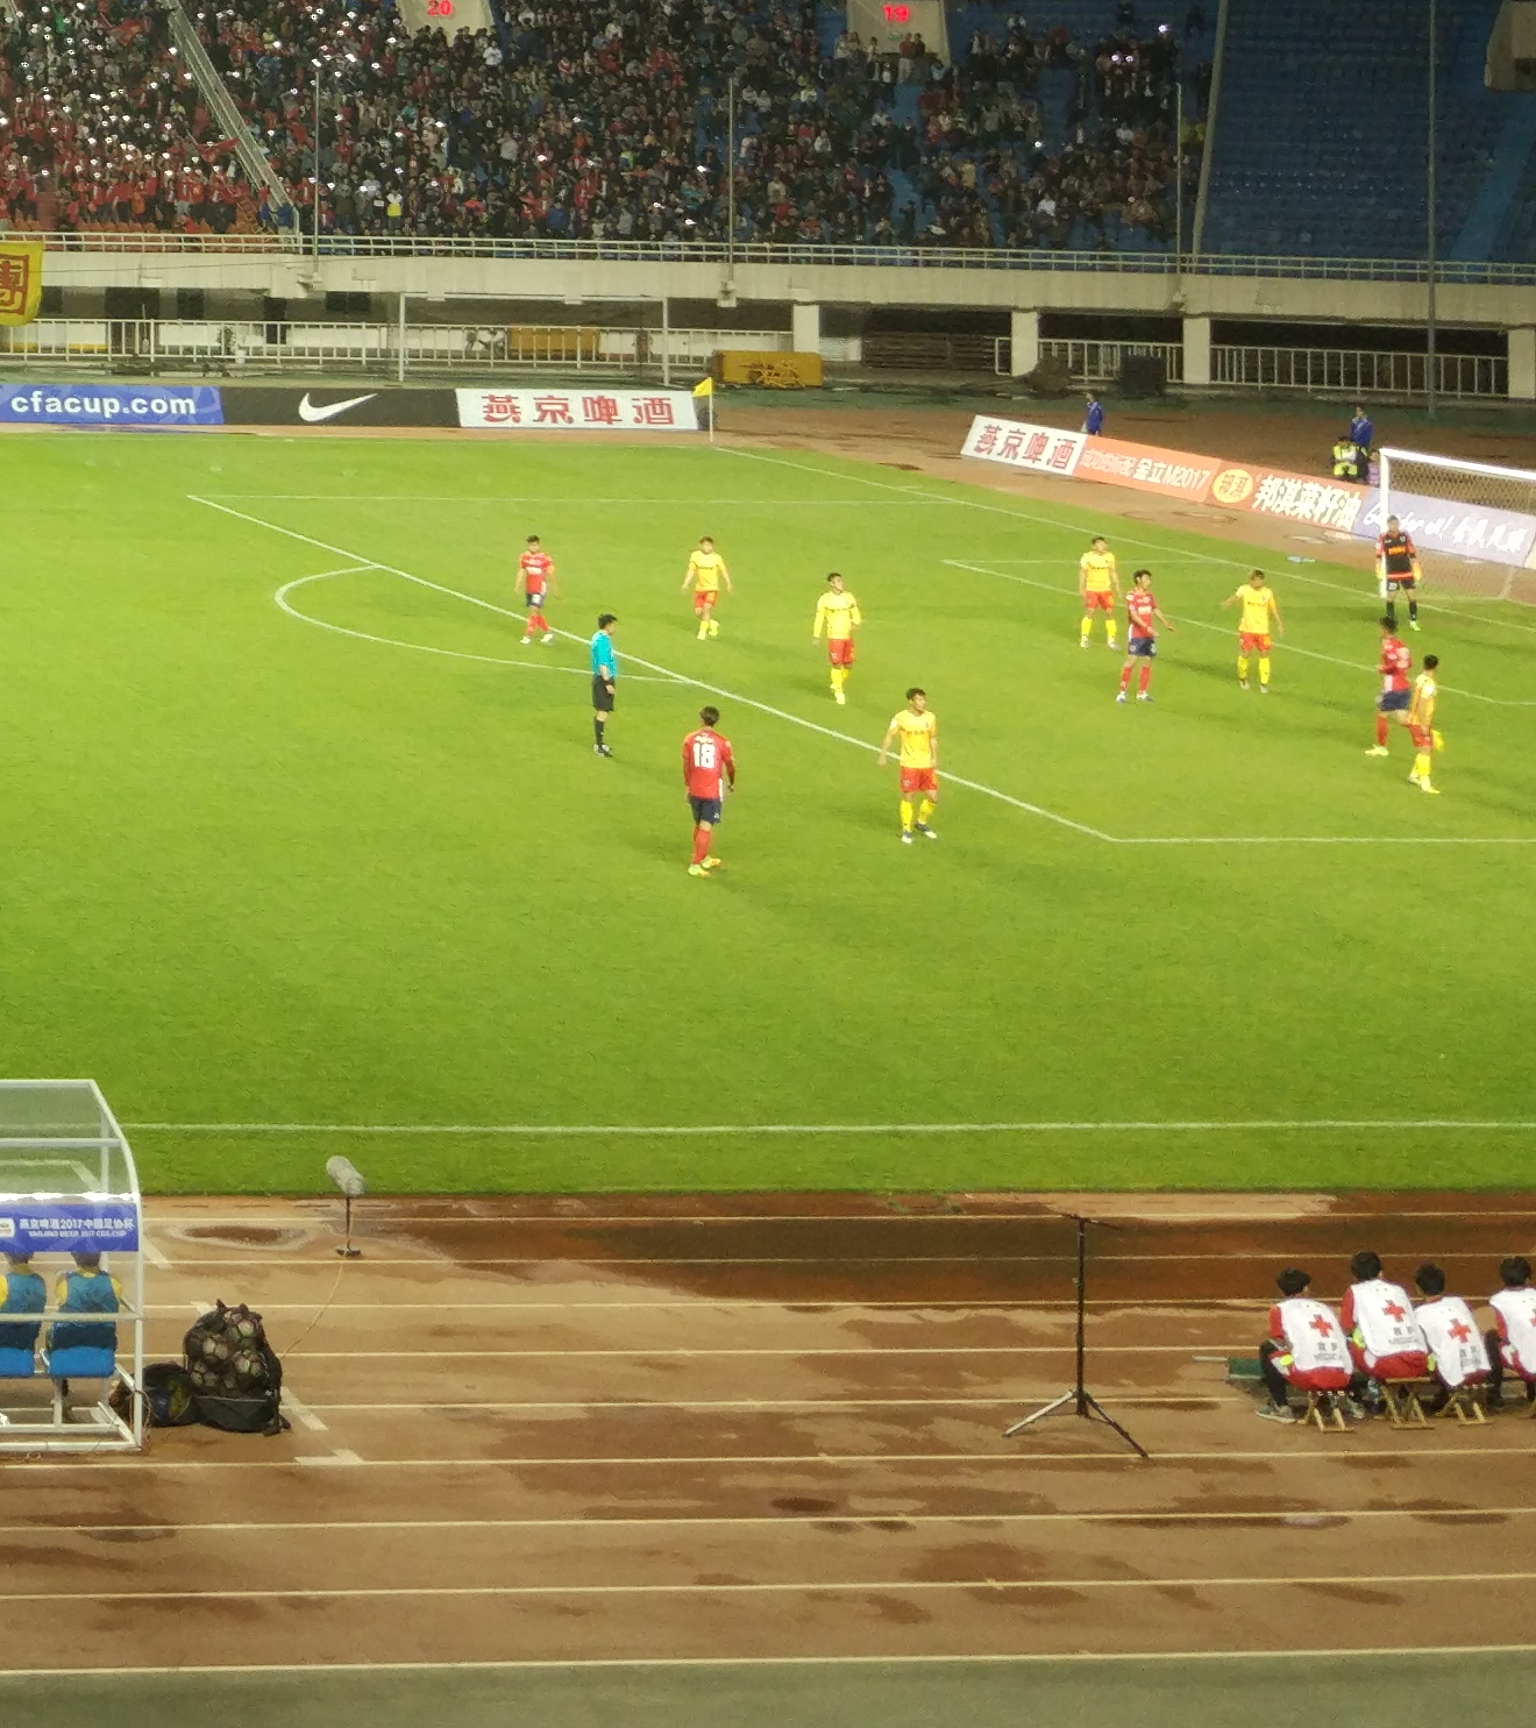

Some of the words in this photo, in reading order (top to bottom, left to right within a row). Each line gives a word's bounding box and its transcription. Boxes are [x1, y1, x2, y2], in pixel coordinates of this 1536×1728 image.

[427, 0, 454, 17] 20
[884, 4, 910, 23] 19
[10, 392, 197, 418] cfacup.com
[481, 394, 676, 426] 燕京啤酒
[973, 424, 1078, 470] 燕京啤酒
[693, 742, 716, 769] 18
